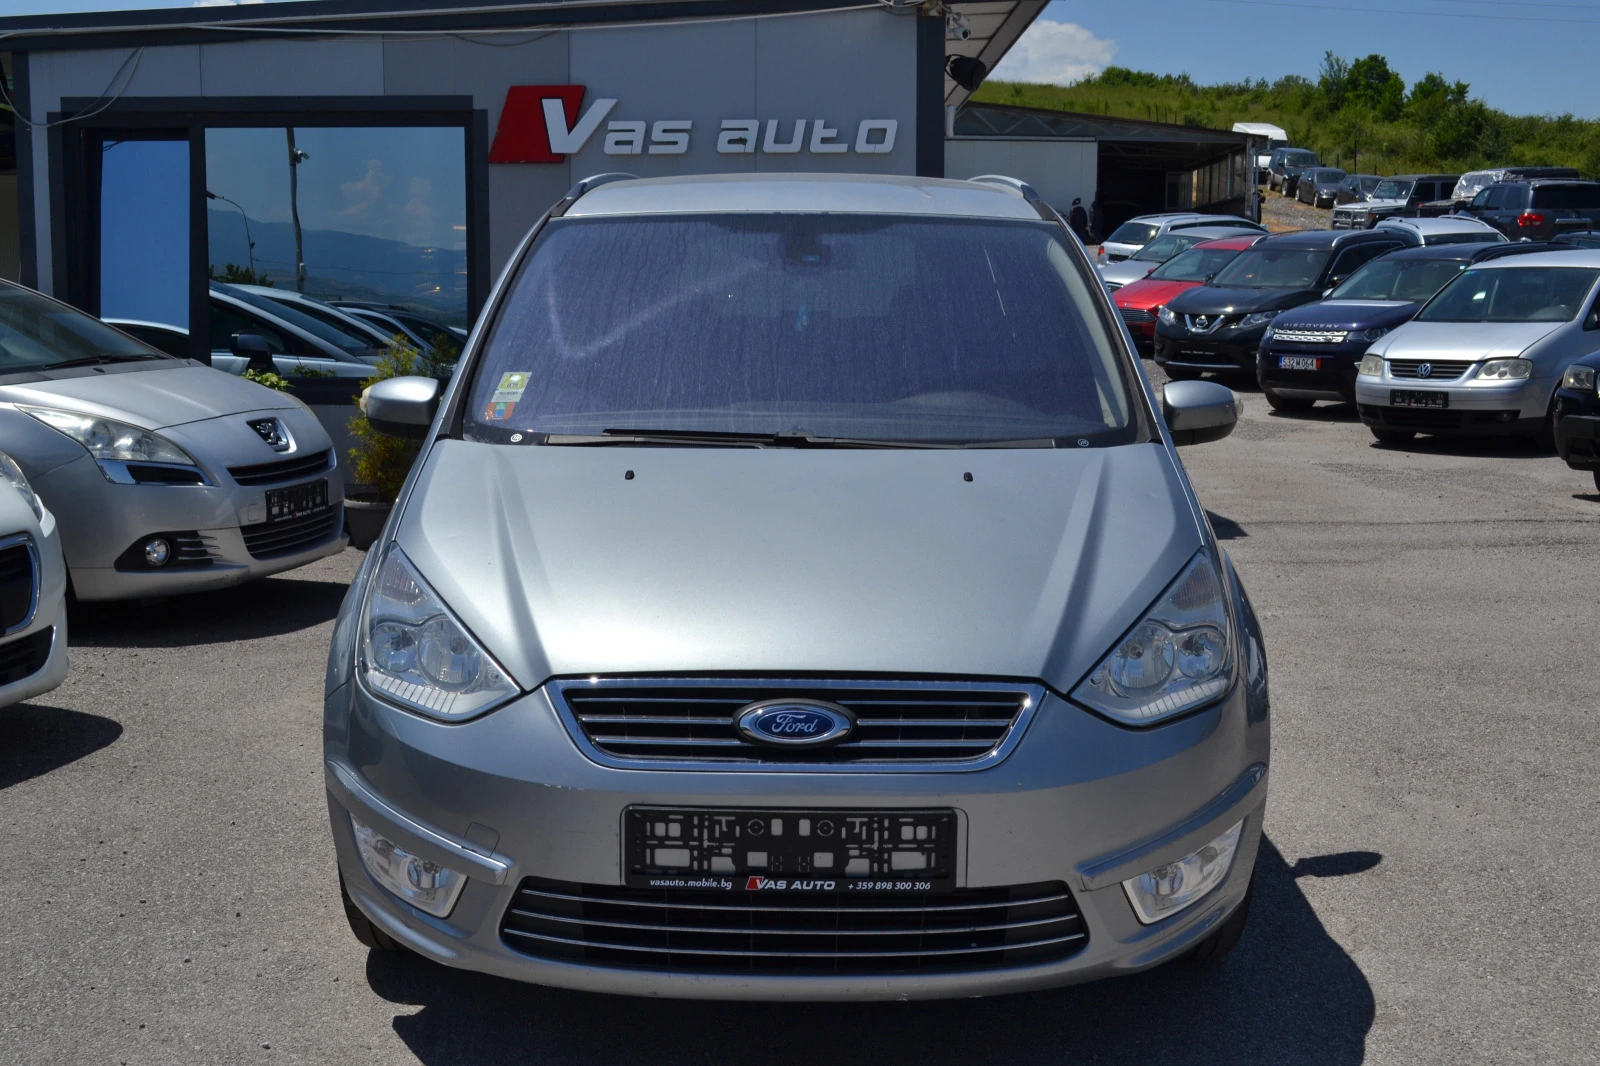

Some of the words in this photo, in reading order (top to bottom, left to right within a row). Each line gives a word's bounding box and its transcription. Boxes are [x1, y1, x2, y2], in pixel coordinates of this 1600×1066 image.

[771, 713, 819, 733] Ford
[650, 878, 733, 890] vasauto.mobile.bg
[755, 878, 787, 890] VAS
[790, 880, 836, 890] AUTO
[856, 882, 875, 890] 359
[875, 882, 893, 890] 898
[894, 882, 912, 890] 300
[913, 882, 931, 890] 306
